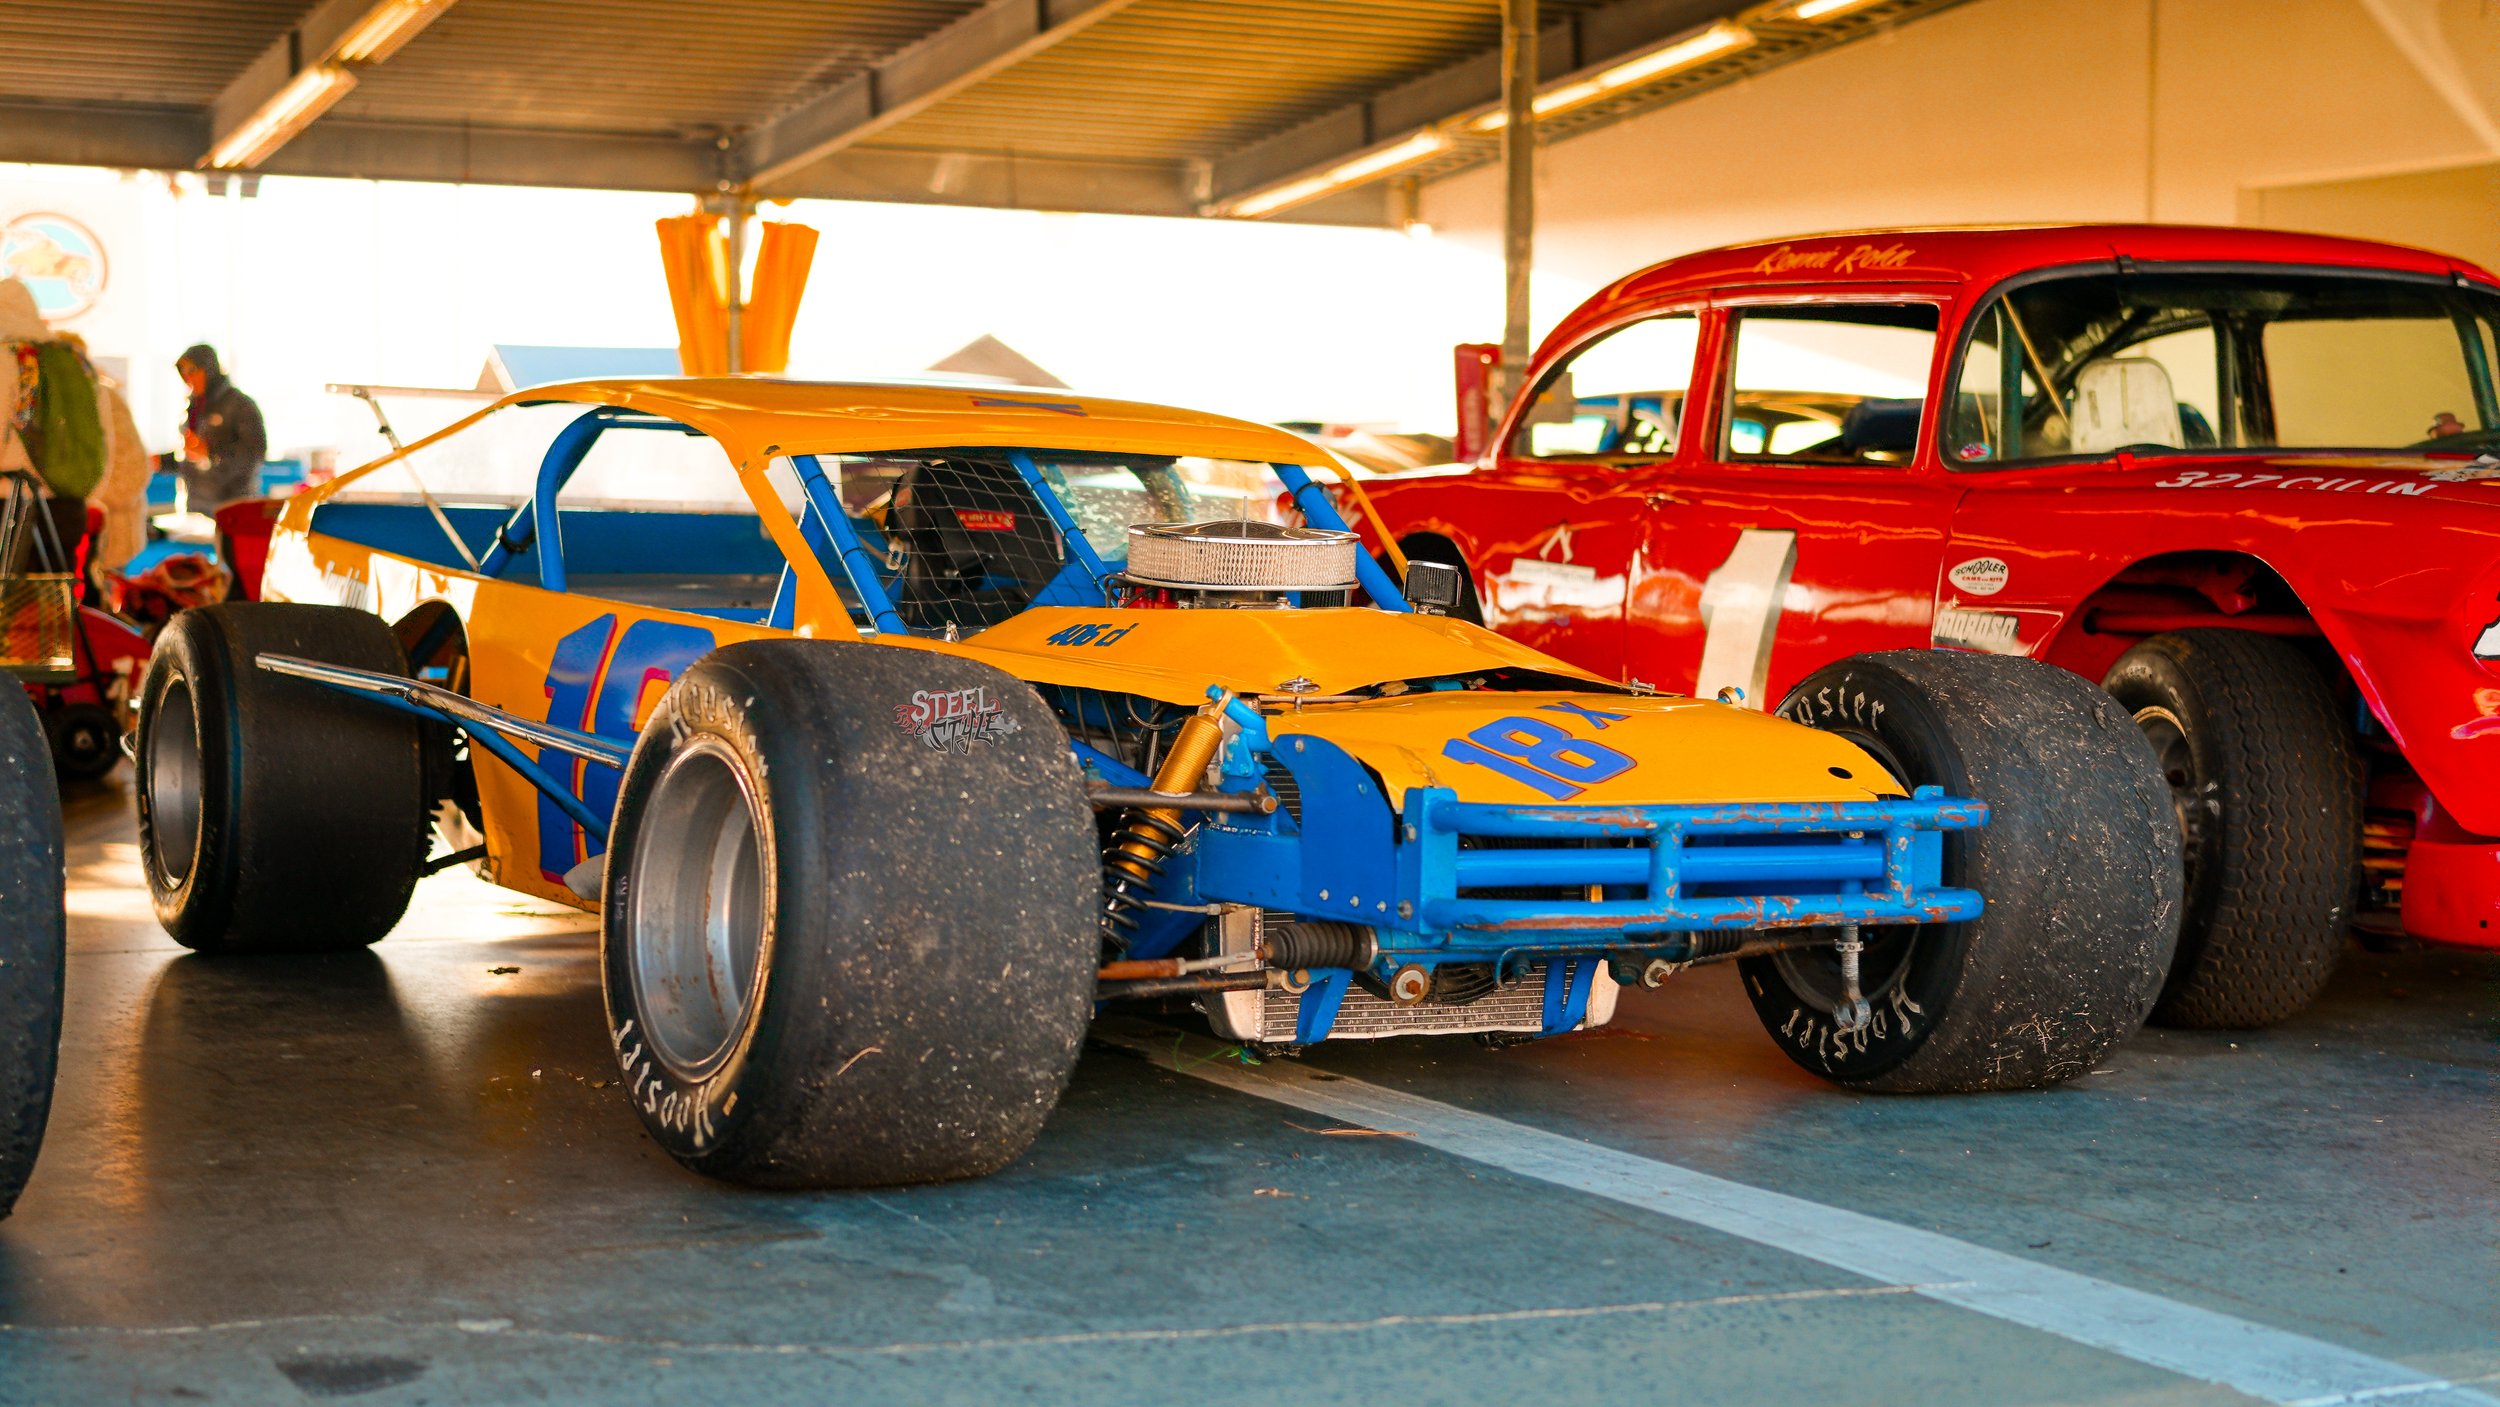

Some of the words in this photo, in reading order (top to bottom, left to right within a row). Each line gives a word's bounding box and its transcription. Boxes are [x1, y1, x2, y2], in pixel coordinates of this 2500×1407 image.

[2156, 471, 2283, 488] 327
[1955, 560, 2006, 575] SCHOOLER
[1045, 623, 1114, 647] 406
[1093, 622, 1140, 647] ci
[1695, 528, 1798, 712] 1
[1934, 611, 2017, 640] MOROSO
[1781, 672, 1886, 731] osier
[1441, 716, 1638, 801] 18
